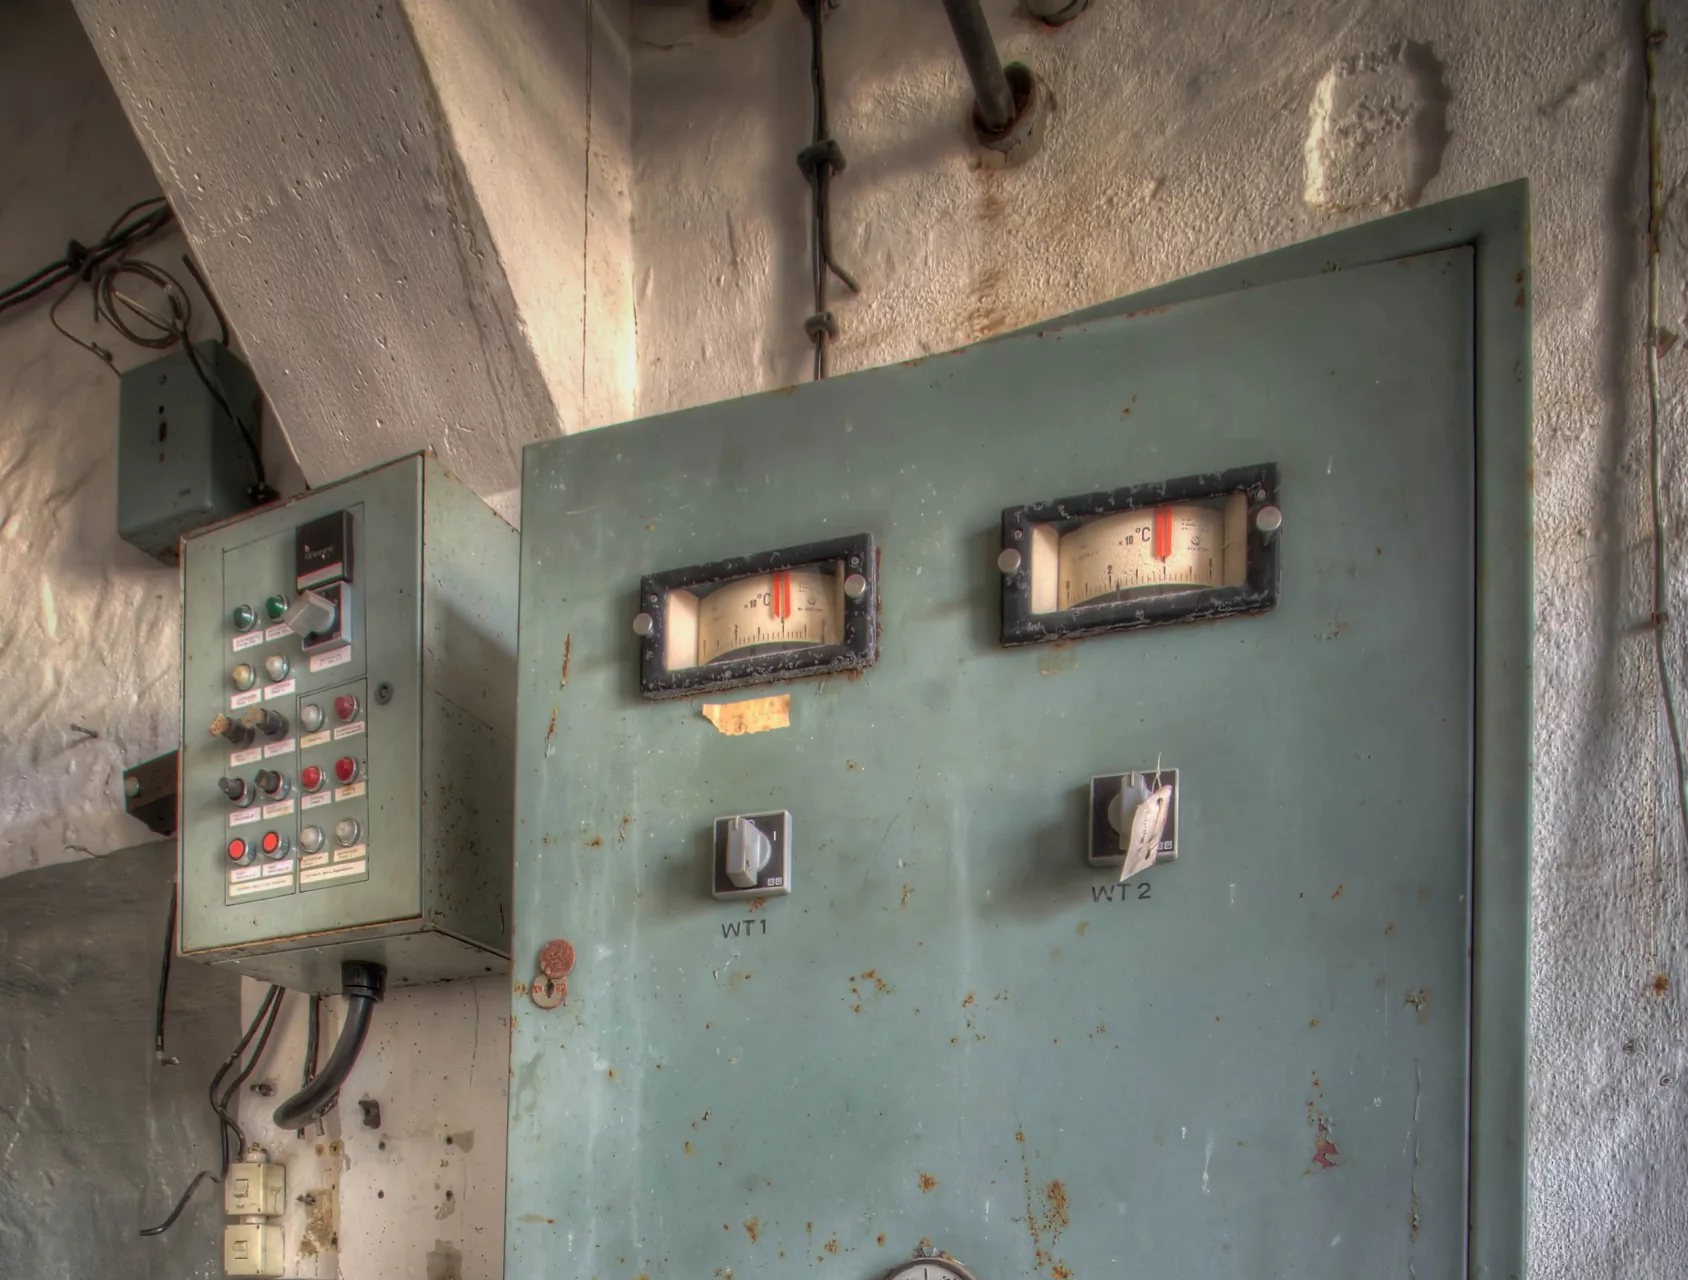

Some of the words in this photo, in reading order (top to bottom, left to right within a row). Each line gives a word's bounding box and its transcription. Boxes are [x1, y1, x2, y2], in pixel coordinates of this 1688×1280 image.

[1135, 526, 1151, 542] °C
[1107, 564, 1113, 575] 2
[757, 592, 771, 607] °C
